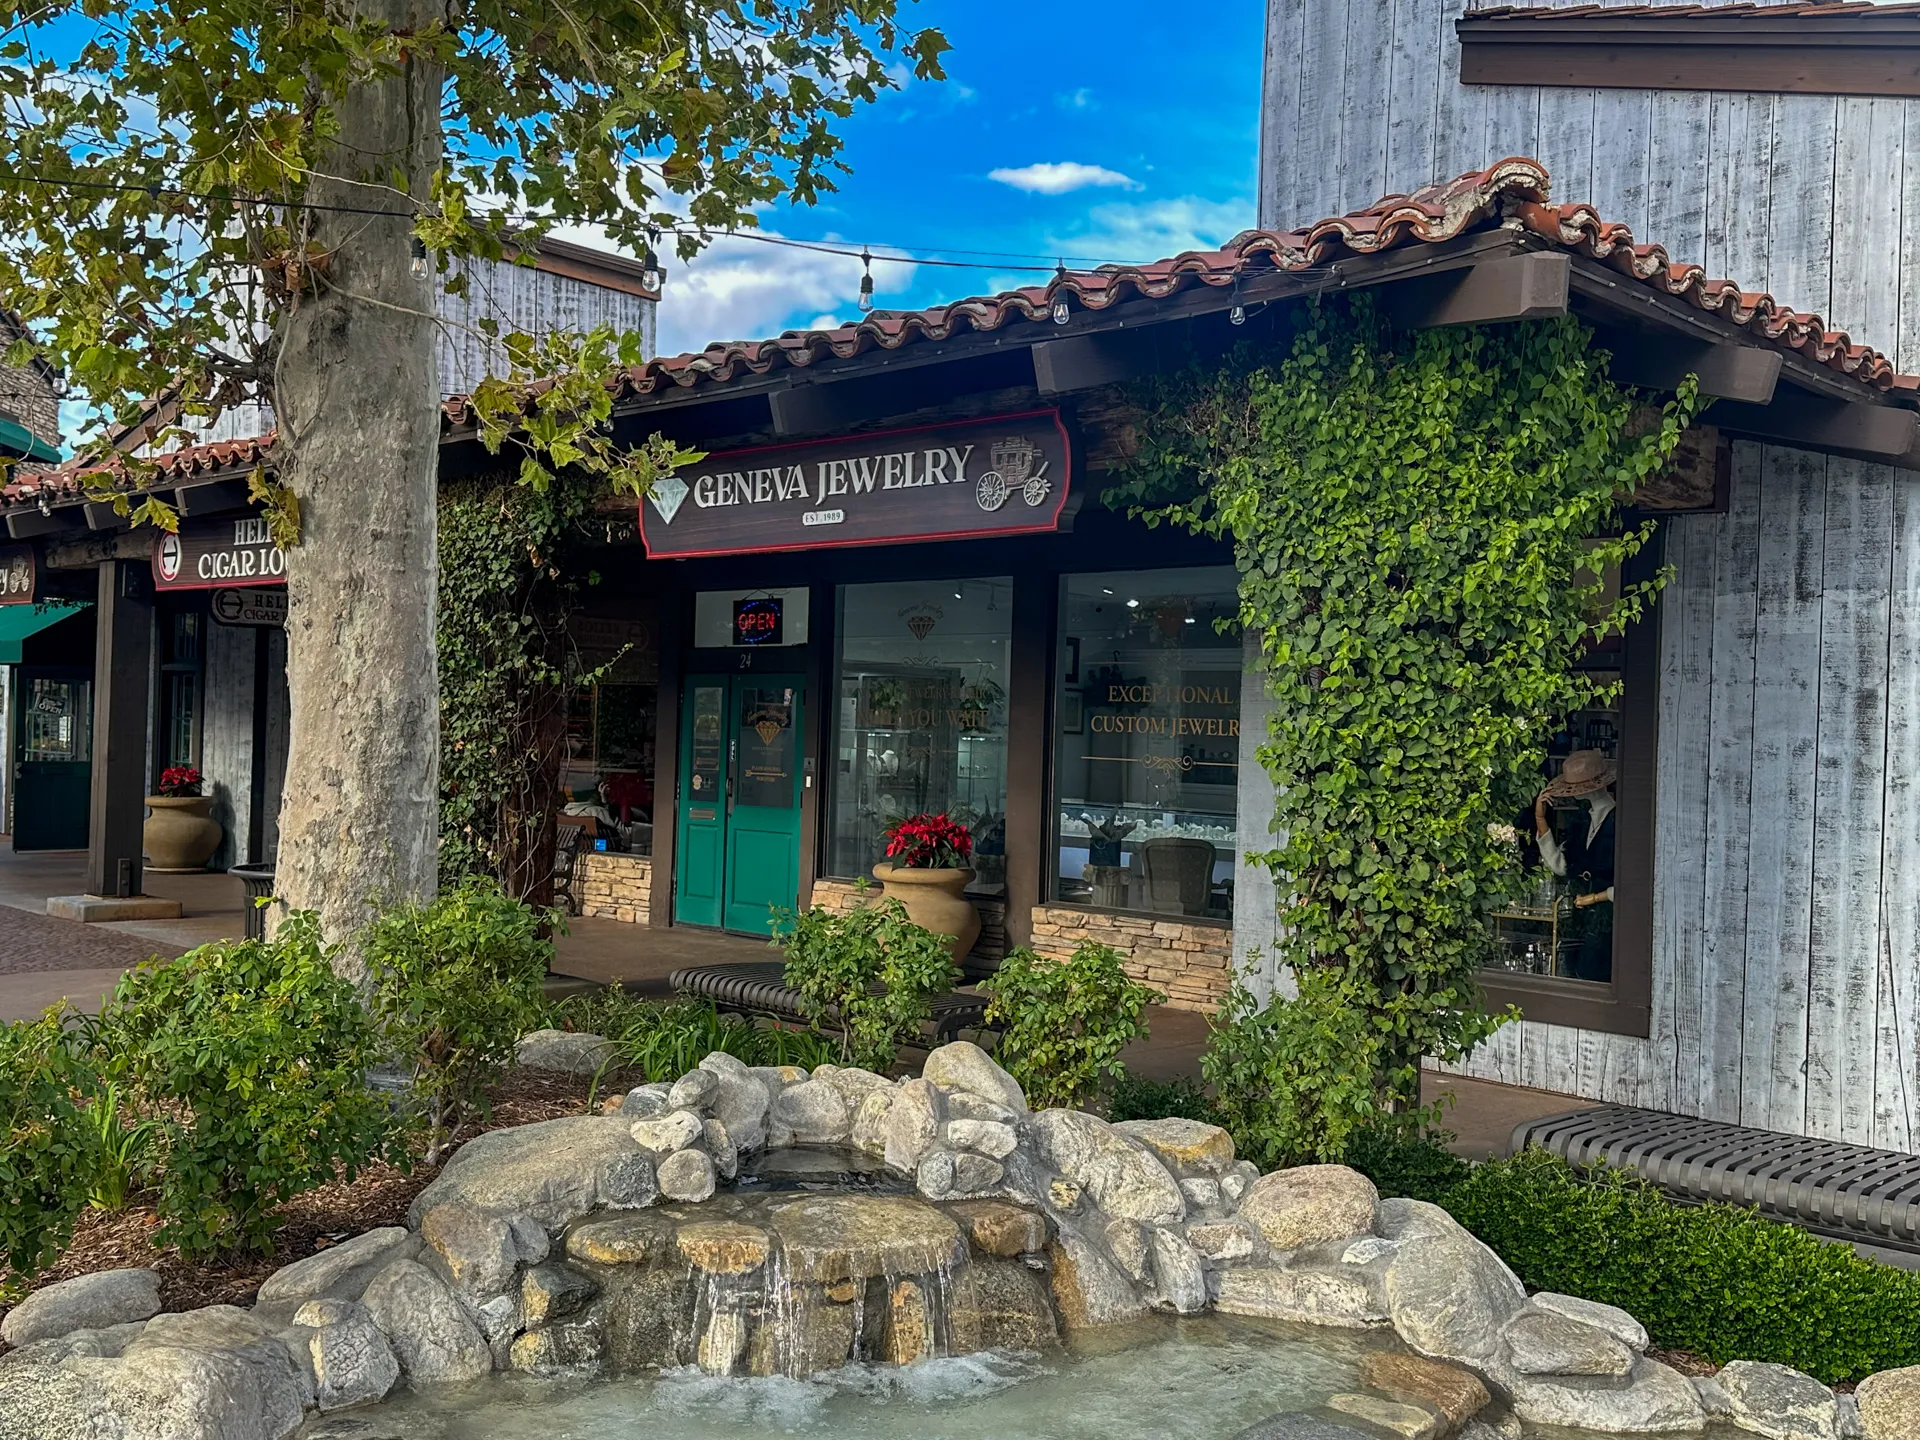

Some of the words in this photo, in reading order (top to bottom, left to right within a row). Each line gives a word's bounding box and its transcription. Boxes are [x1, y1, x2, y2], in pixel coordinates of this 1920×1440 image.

[694, 463, 810, 510] GENEVA
[815, 444, 975, 505] JEWELRY
[823, 512, 841, 521] 1989
[198, 549, 256, 579] CIGAR
[259, 546, 288, 575] LO
[243, 608, 279, 622] CIGAR
[738, 612, 775, 631] OPEN
[739, 653, 751, 668] 24
[1108, 685, 1233, 704] EXCEPTIONAL
[39, 703, 63, 714] OPEN
[908, 707, 943, 728] YOU
[947, 709, 989, 728] WAIT
[1091, 716, 1165, 734] CUSTOM
[1169, 718, 1240, 739] JEWELR
